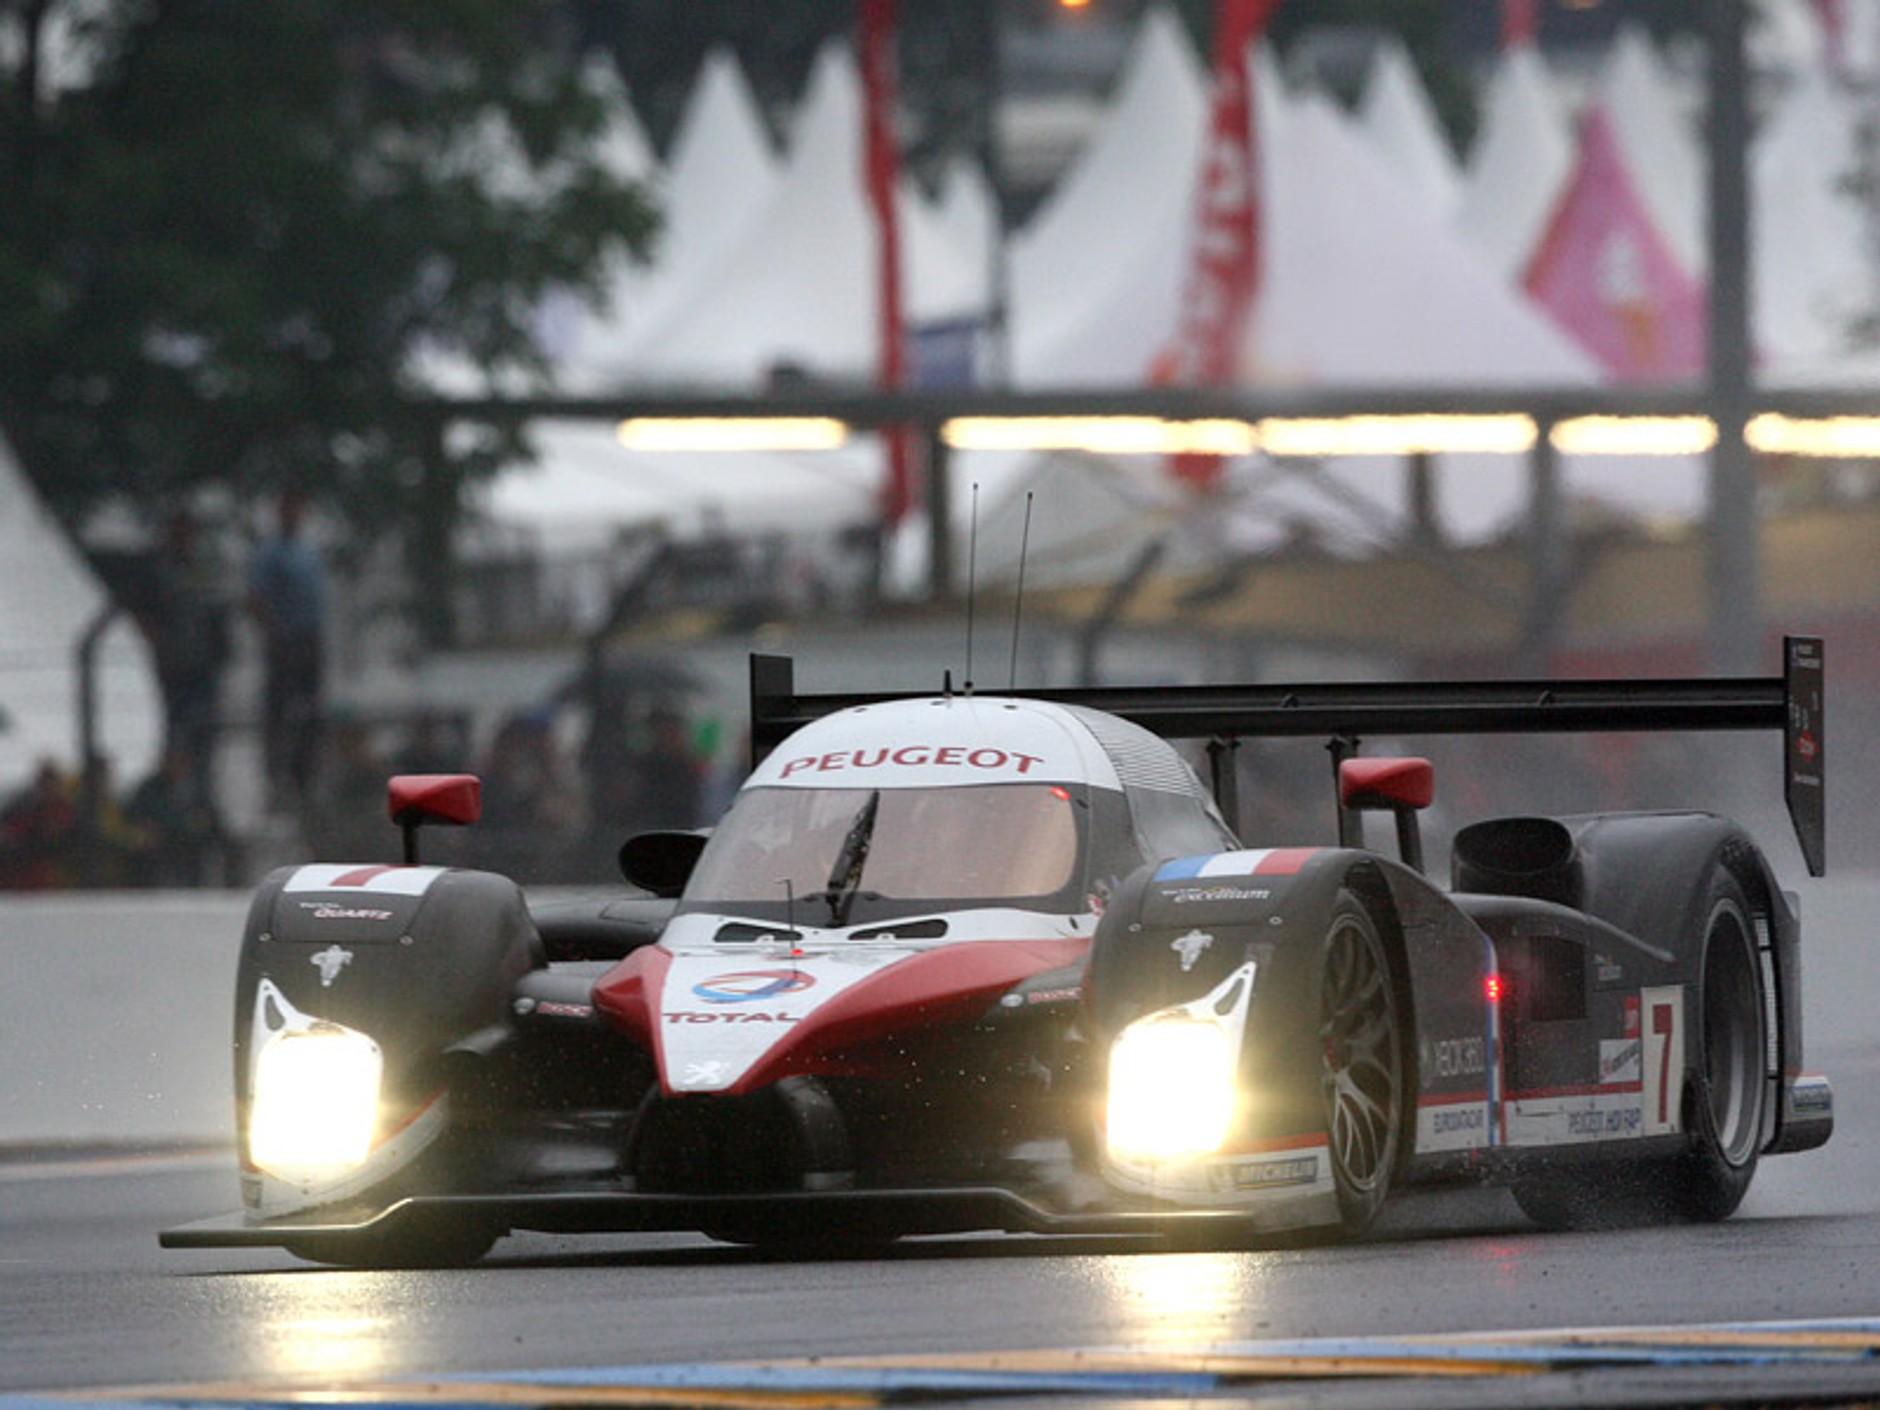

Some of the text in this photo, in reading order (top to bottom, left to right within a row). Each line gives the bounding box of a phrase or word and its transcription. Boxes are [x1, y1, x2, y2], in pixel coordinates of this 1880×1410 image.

[779, 746, 1044, 779] PEUGEOT
[662, 1012, 802, 1024] TOTAL
[1652, 1003, 1674, 1123] 7
